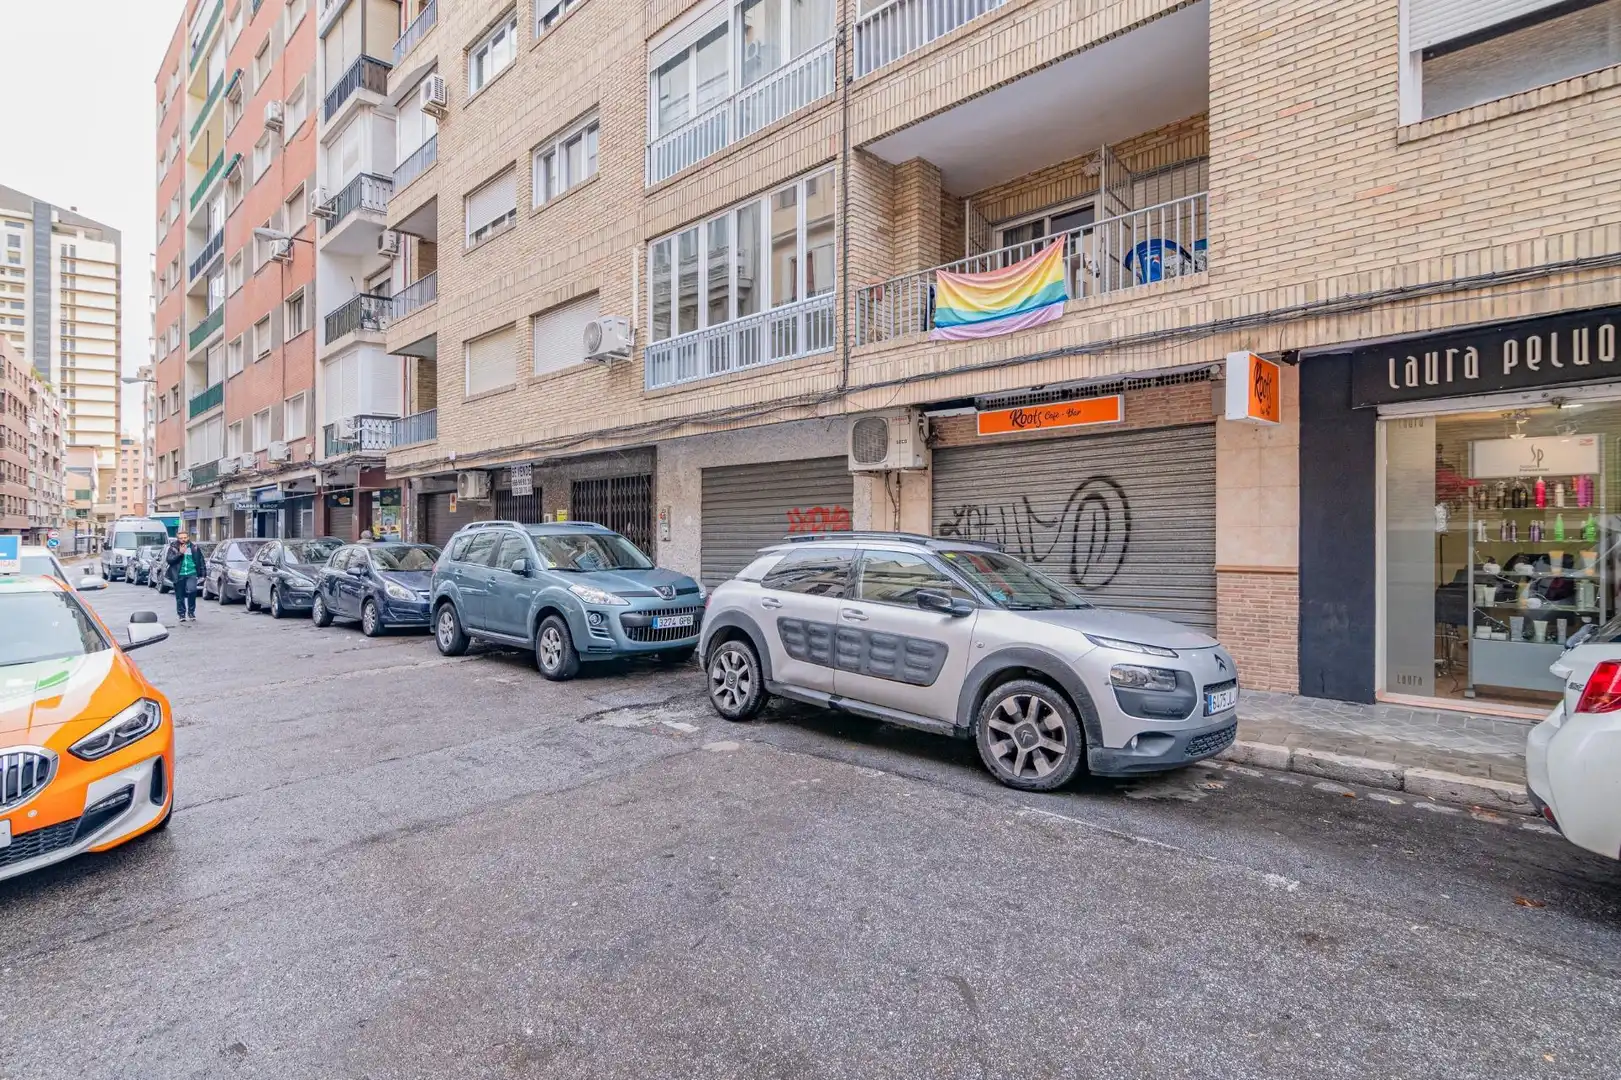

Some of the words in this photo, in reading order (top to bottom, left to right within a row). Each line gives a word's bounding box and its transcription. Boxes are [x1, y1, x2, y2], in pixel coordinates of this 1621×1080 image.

[1254, 362, 1272, 409] Roots
[1009, 408, 1042, 428] Roots
[1066, 407, 1081, 418] Bar
[659, 617, 677, 627] 3274
[1213, 692, 1227, 710] 6475
